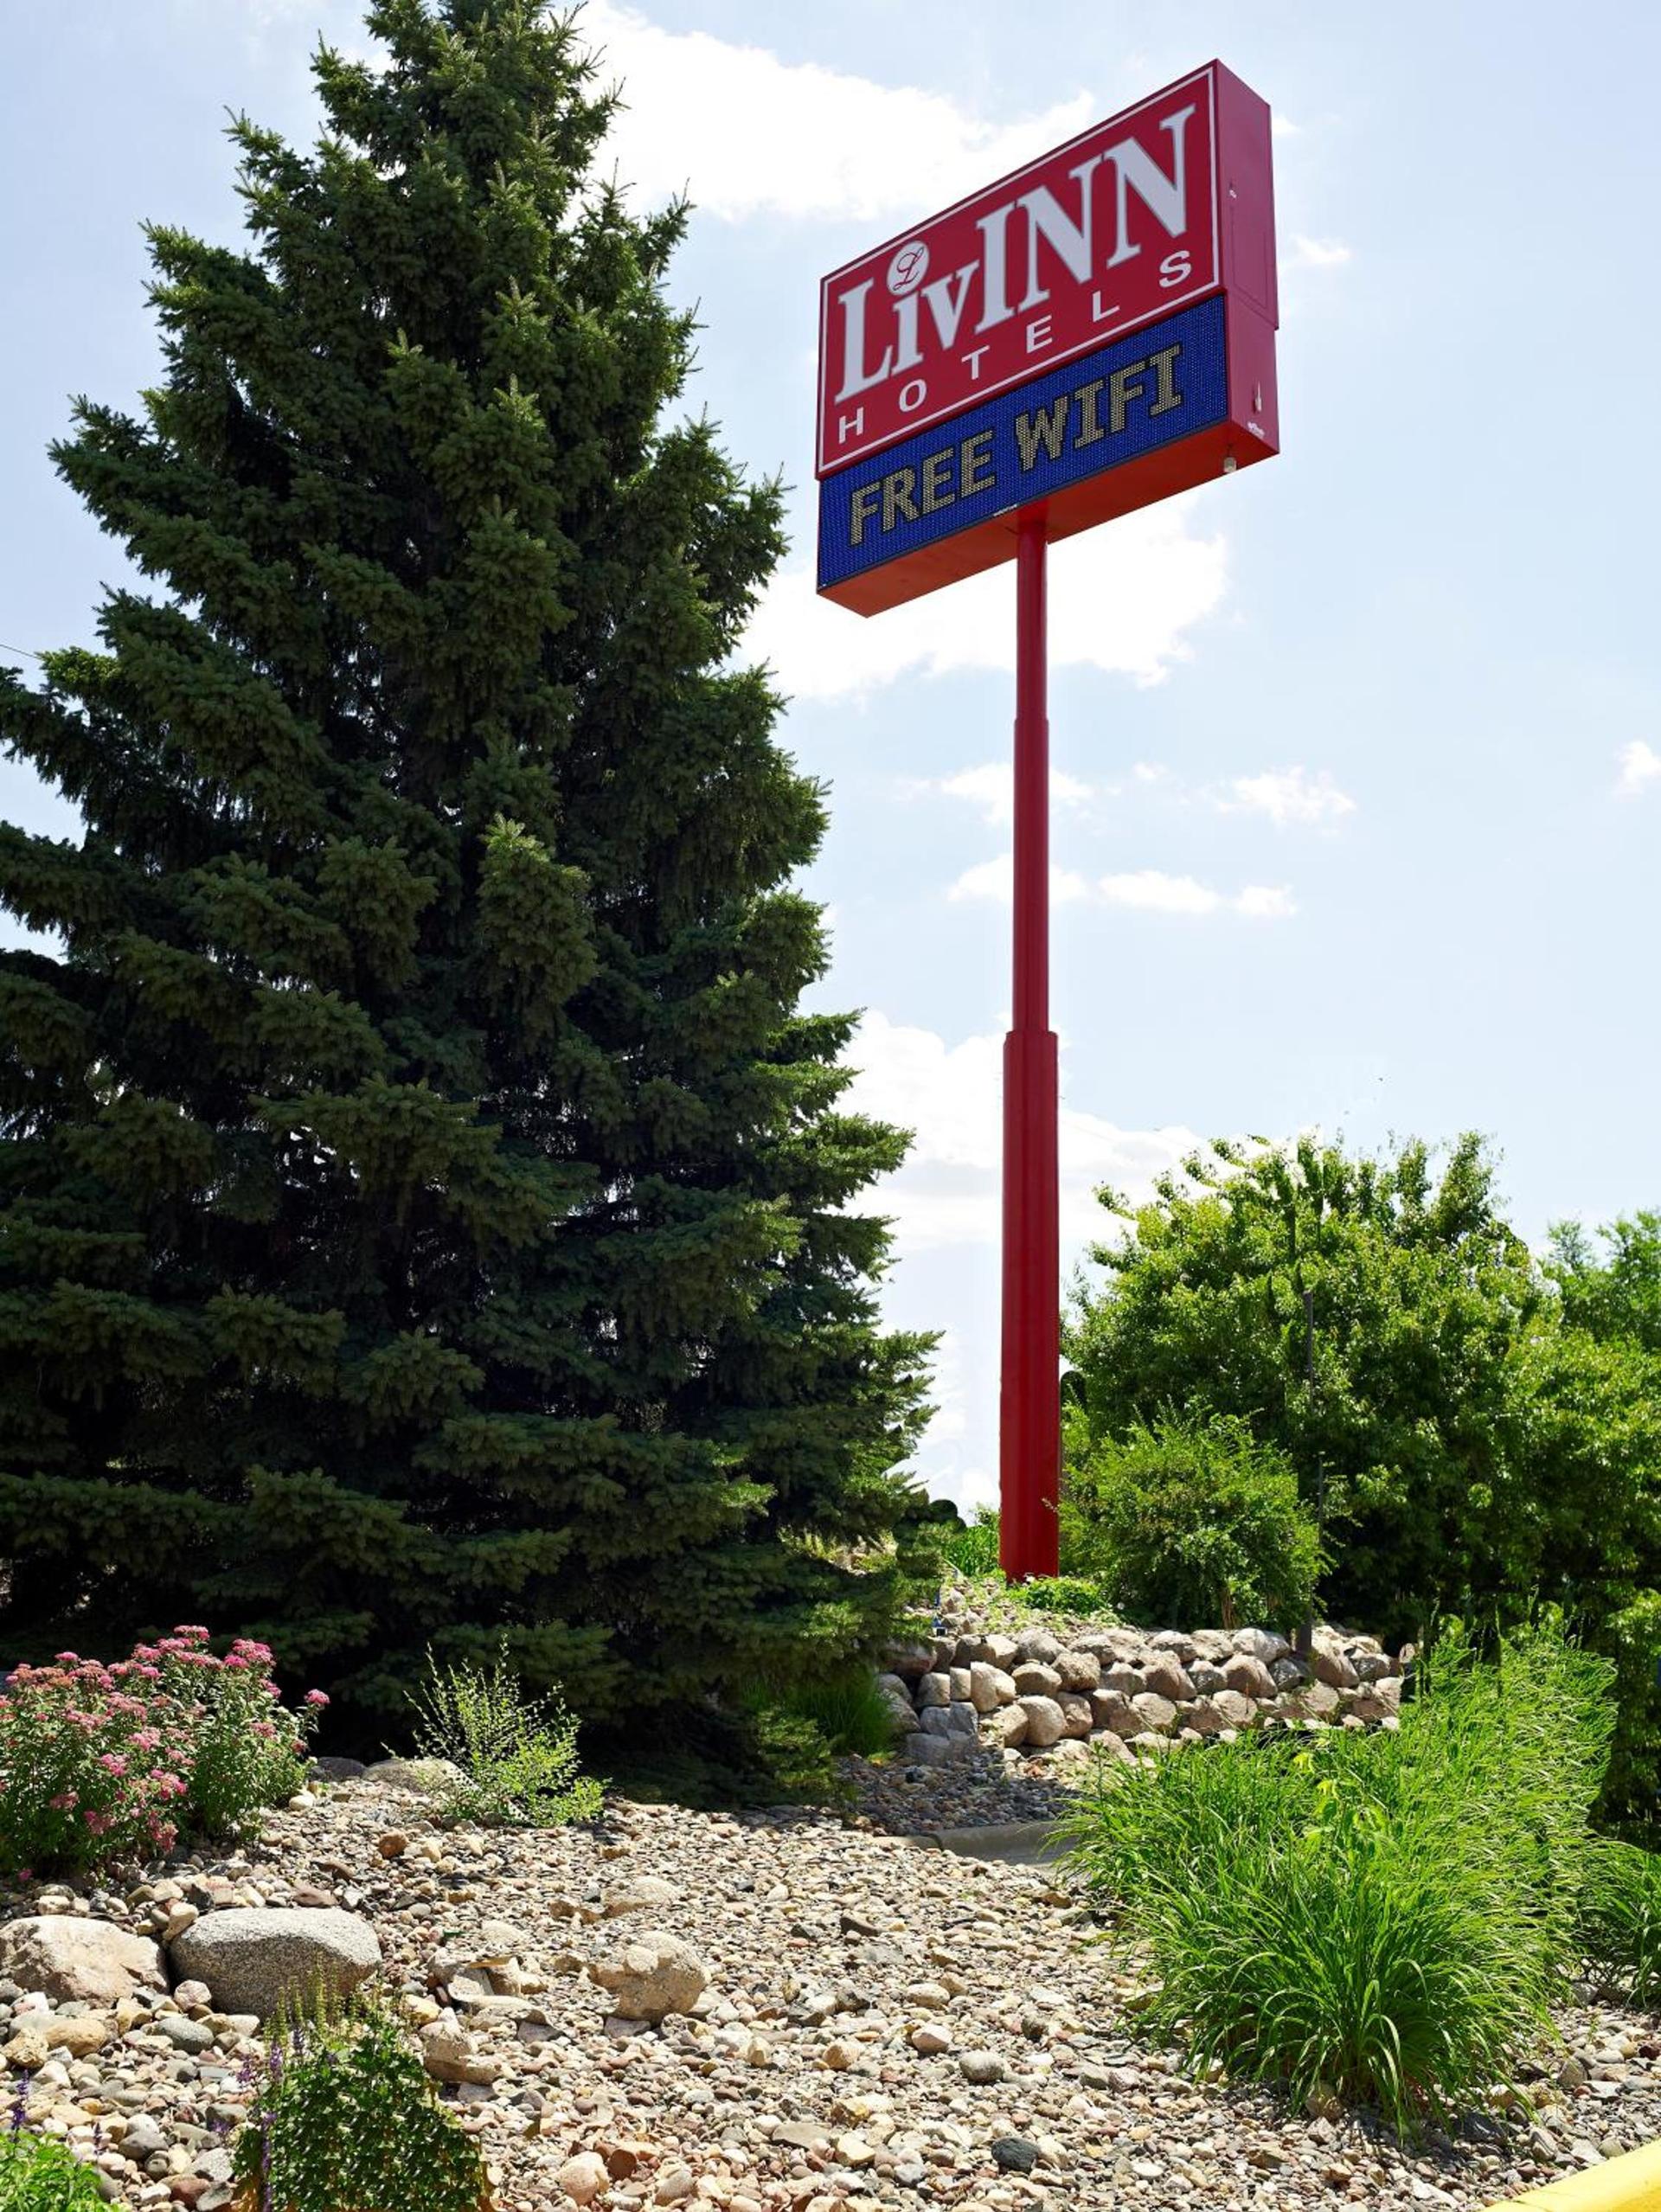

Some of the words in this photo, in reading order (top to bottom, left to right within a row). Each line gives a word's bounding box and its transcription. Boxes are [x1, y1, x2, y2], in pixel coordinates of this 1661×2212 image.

[834, 105, 1196, 404] LivINN
[837, 250, 1192, 444] HOTELS
[850, 430, 997, 548] FREE
[1015, 343, 1183, 472] WIFI
